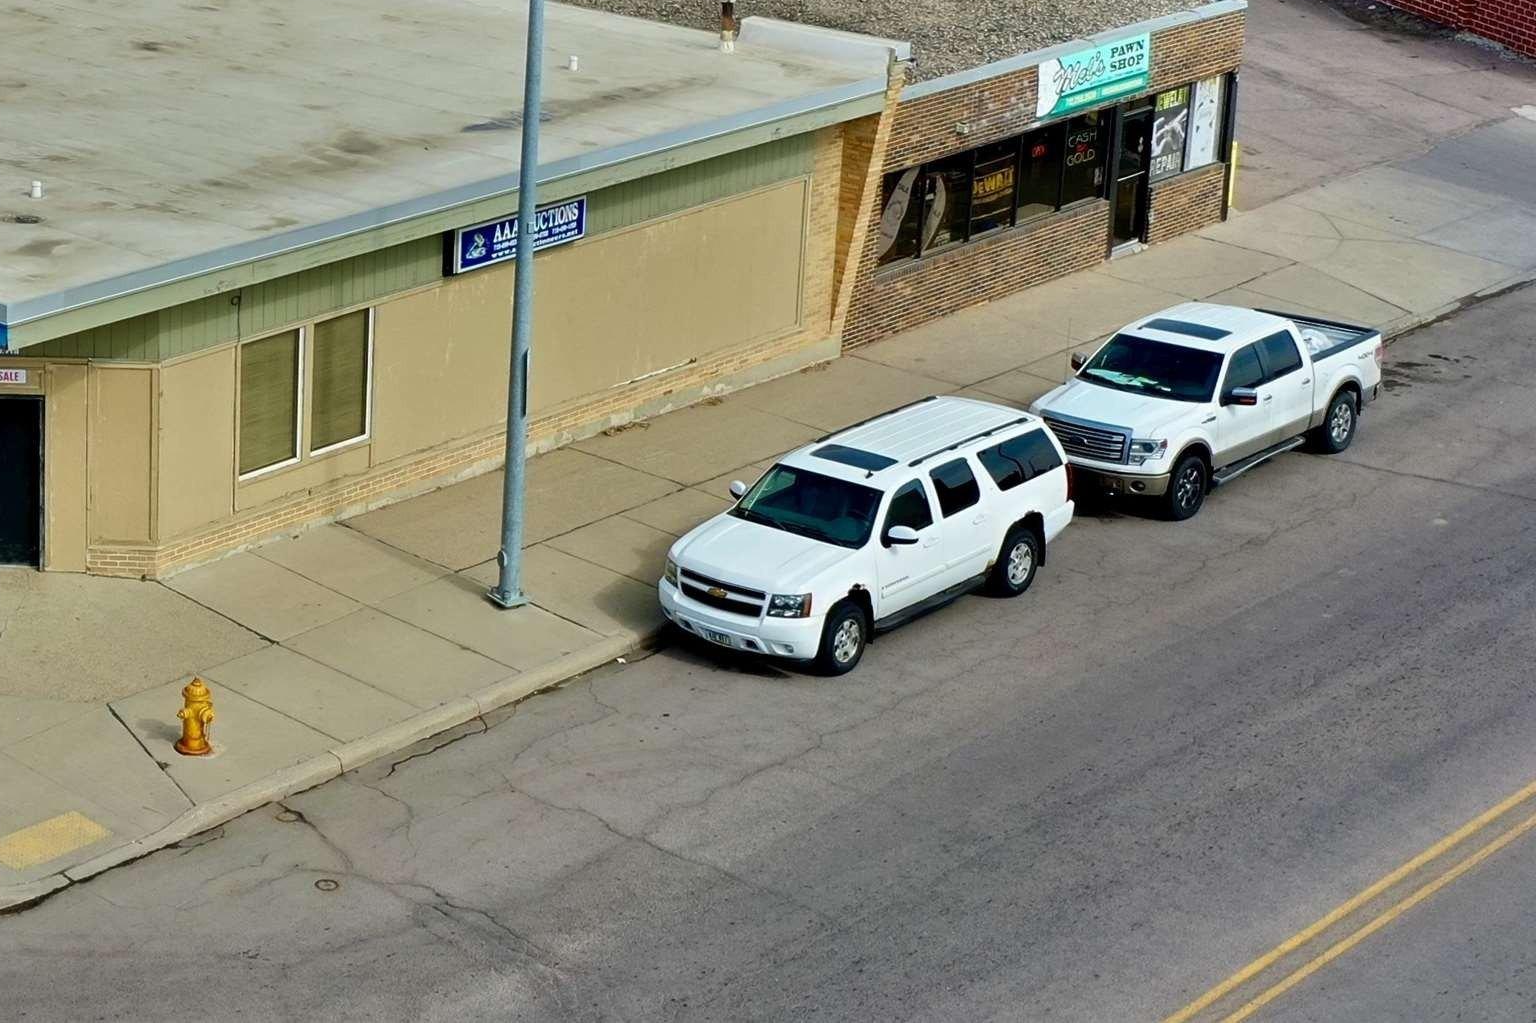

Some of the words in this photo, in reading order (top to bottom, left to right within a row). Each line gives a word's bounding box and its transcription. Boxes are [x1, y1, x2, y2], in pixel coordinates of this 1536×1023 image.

[1110, 39, 1145, 59] PAWN
[1109, 53, 1145, 73] SHOP
[1068, 128, 1097, 148] CASH
[1066, 148, 1096, 166] GOLD
[1149, 151, 1182, 177] REPAIR
[493, 219, 519, 243] AAA
[533, 202, 579, 232] UCTIONS
